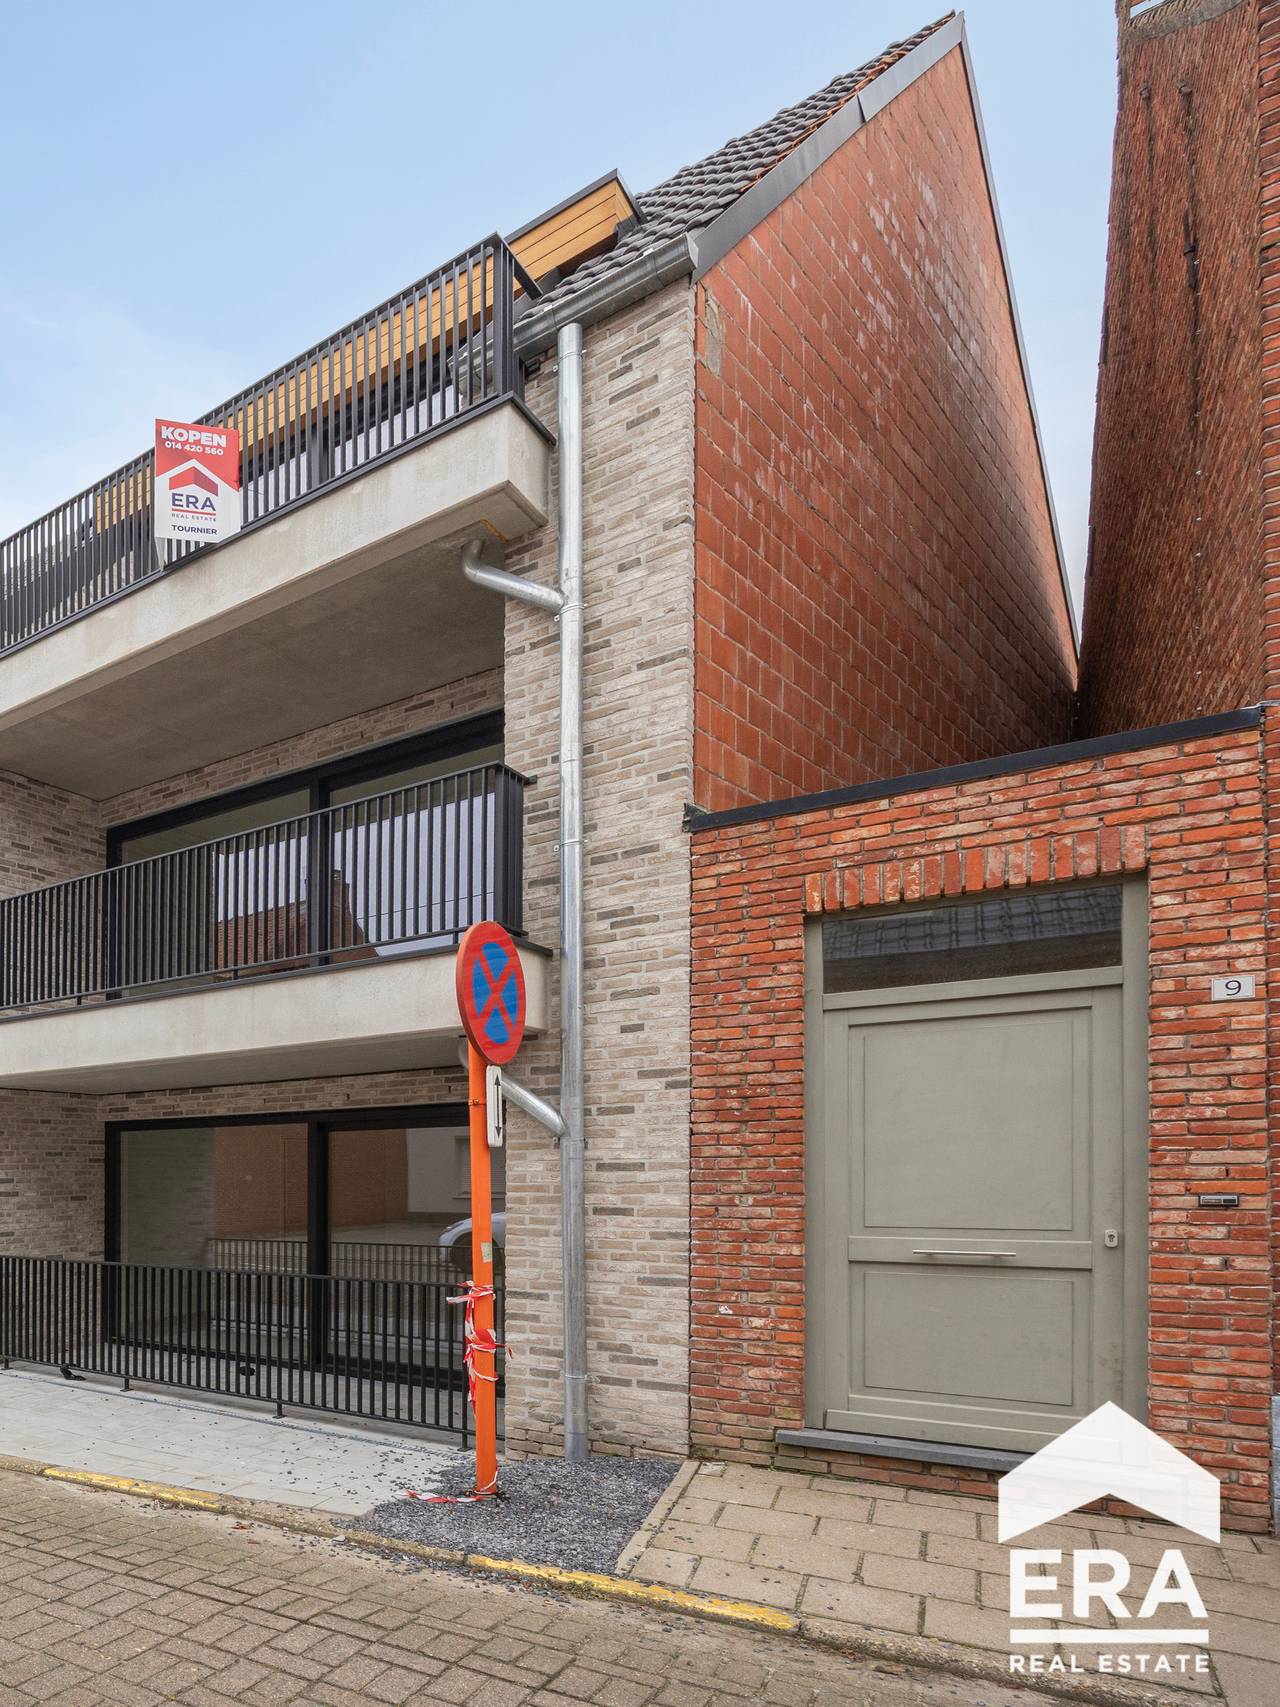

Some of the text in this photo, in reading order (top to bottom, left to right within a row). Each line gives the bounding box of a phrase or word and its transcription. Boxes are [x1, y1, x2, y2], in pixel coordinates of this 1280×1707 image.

[161, 426, 227, 448] KOPEN
[165, 440, 224, 456] 014 420 560
[171, 492, 216, 512] ERA
[171, 524, 218, 536] TOURNIER
[1225, 980, 1241, 996] 9
